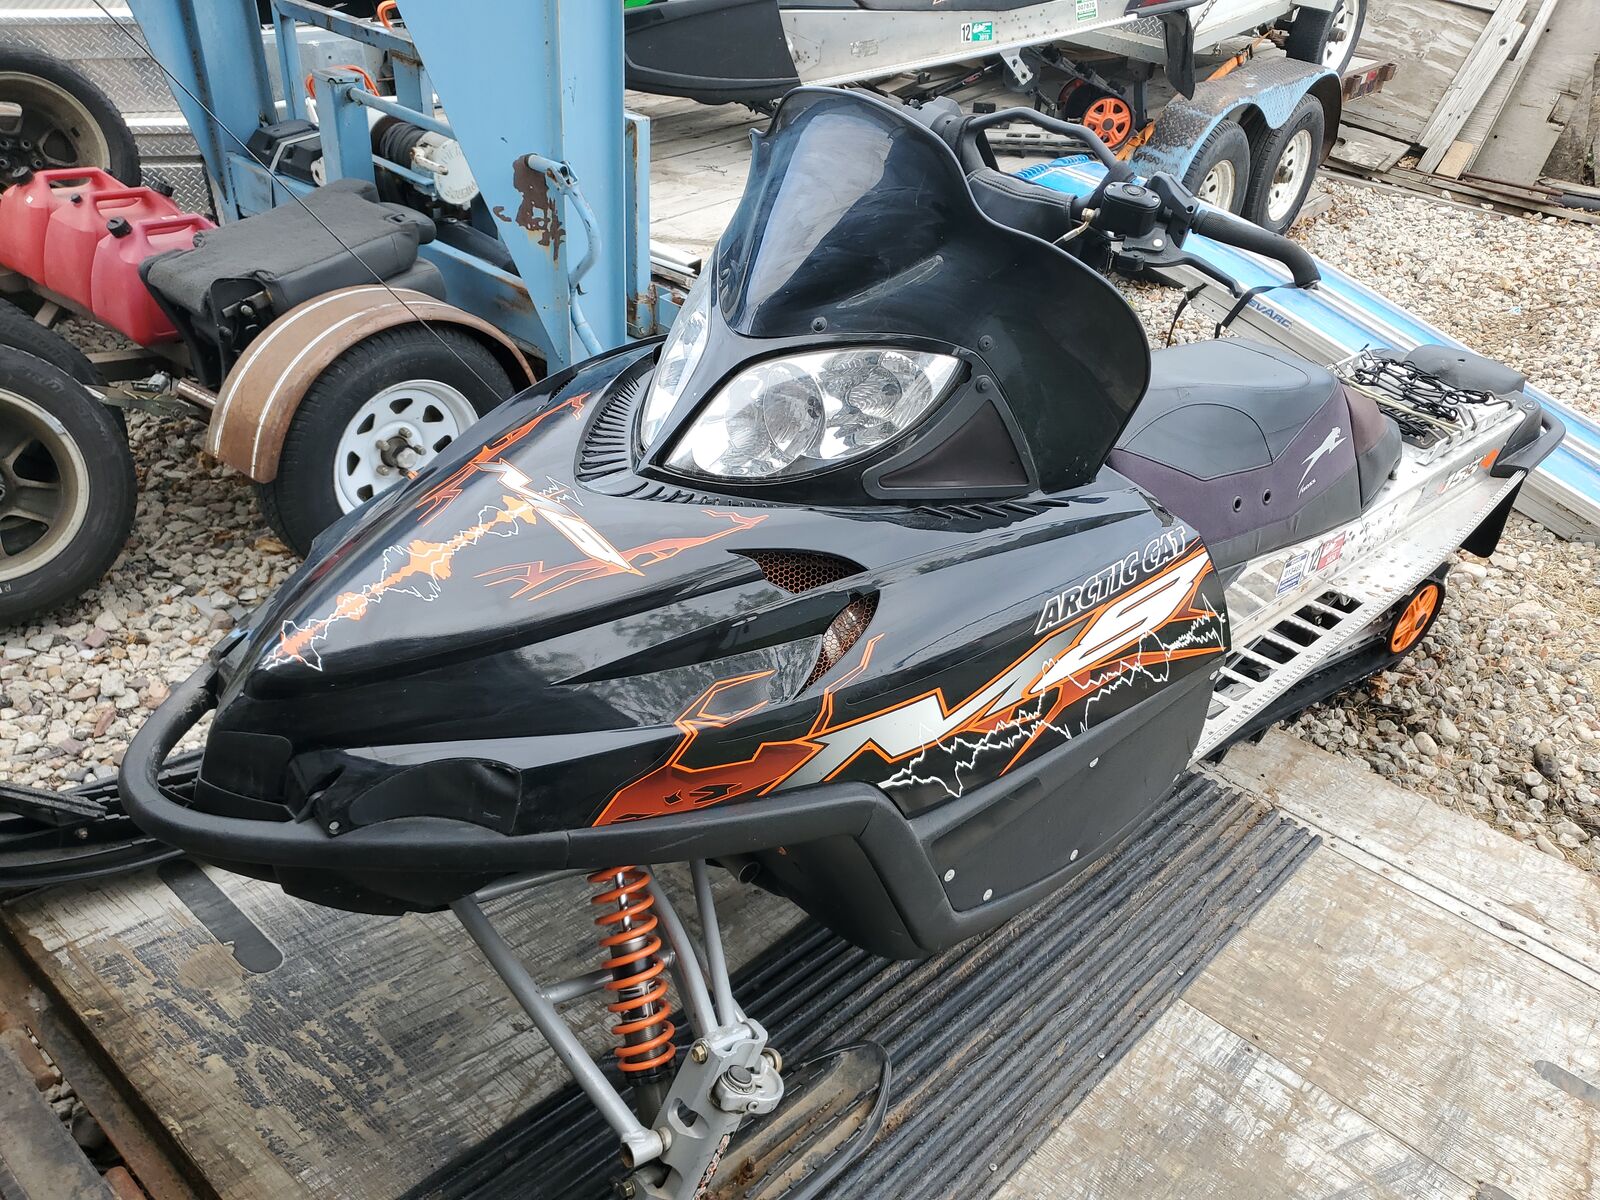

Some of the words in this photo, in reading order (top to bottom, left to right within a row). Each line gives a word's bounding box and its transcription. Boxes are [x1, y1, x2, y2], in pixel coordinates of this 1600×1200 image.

[962, 24, 971, 42] 12
[1248, 299, 1293, 329] EVARC
[1034, 550, 1139, 636] ARCTIC
[1142, 525, 1187, 573] CAT
